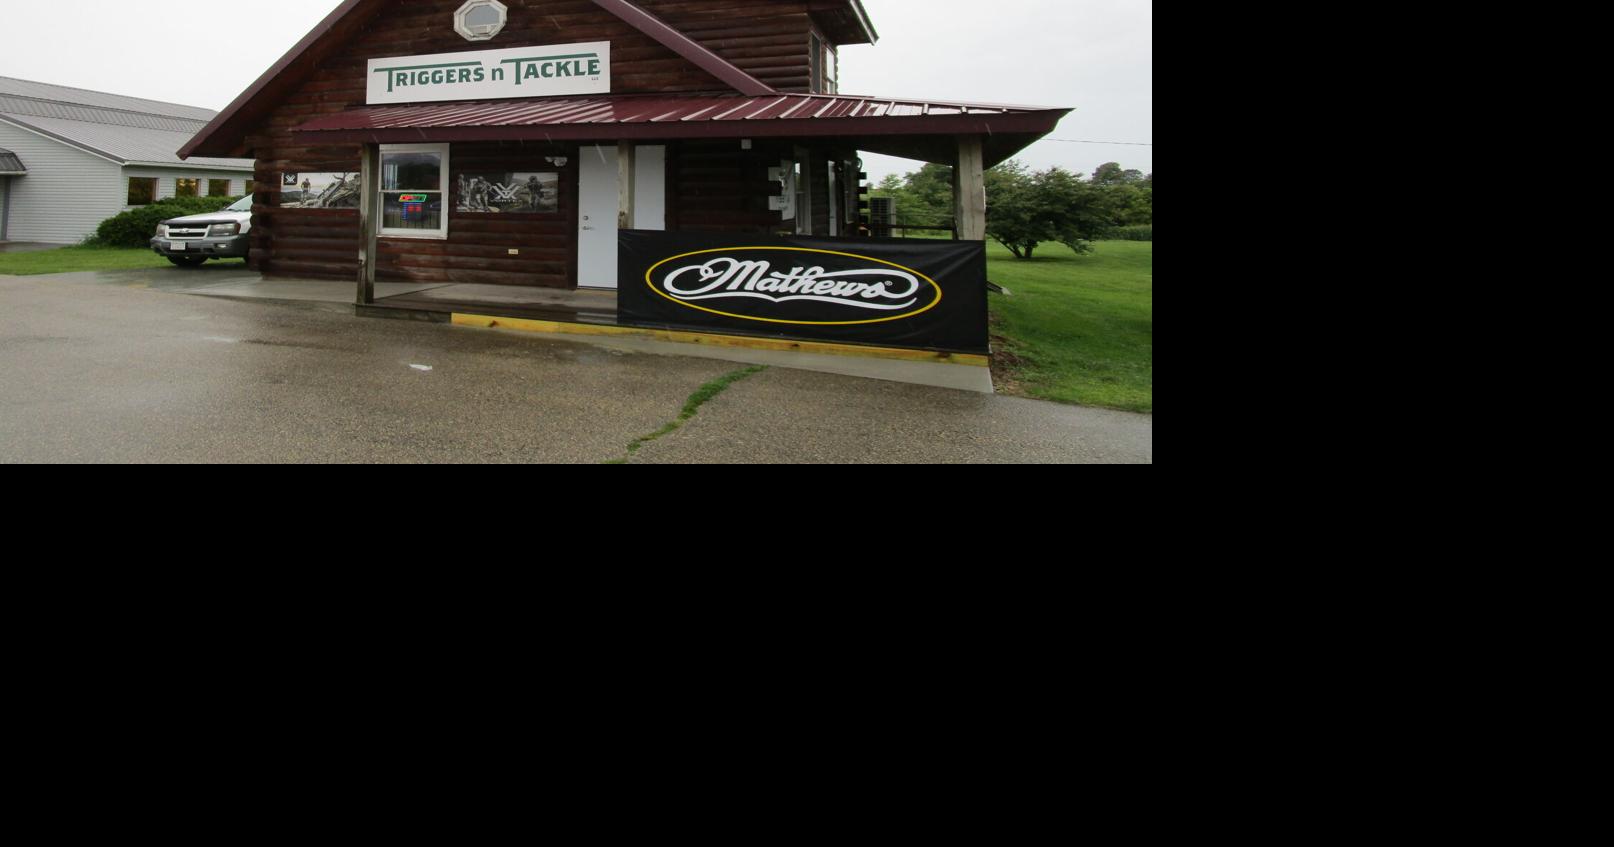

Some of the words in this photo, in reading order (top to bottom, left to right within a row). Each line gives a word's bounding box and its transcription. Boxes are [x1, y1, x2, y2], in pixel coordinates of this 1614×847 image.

[373, 61, 485, 92] TRIGGERS
[491, 66, 504, 81] n
[500, 52, 601, 85] TACKLE
[663, 257, 919, 299] Mathews
